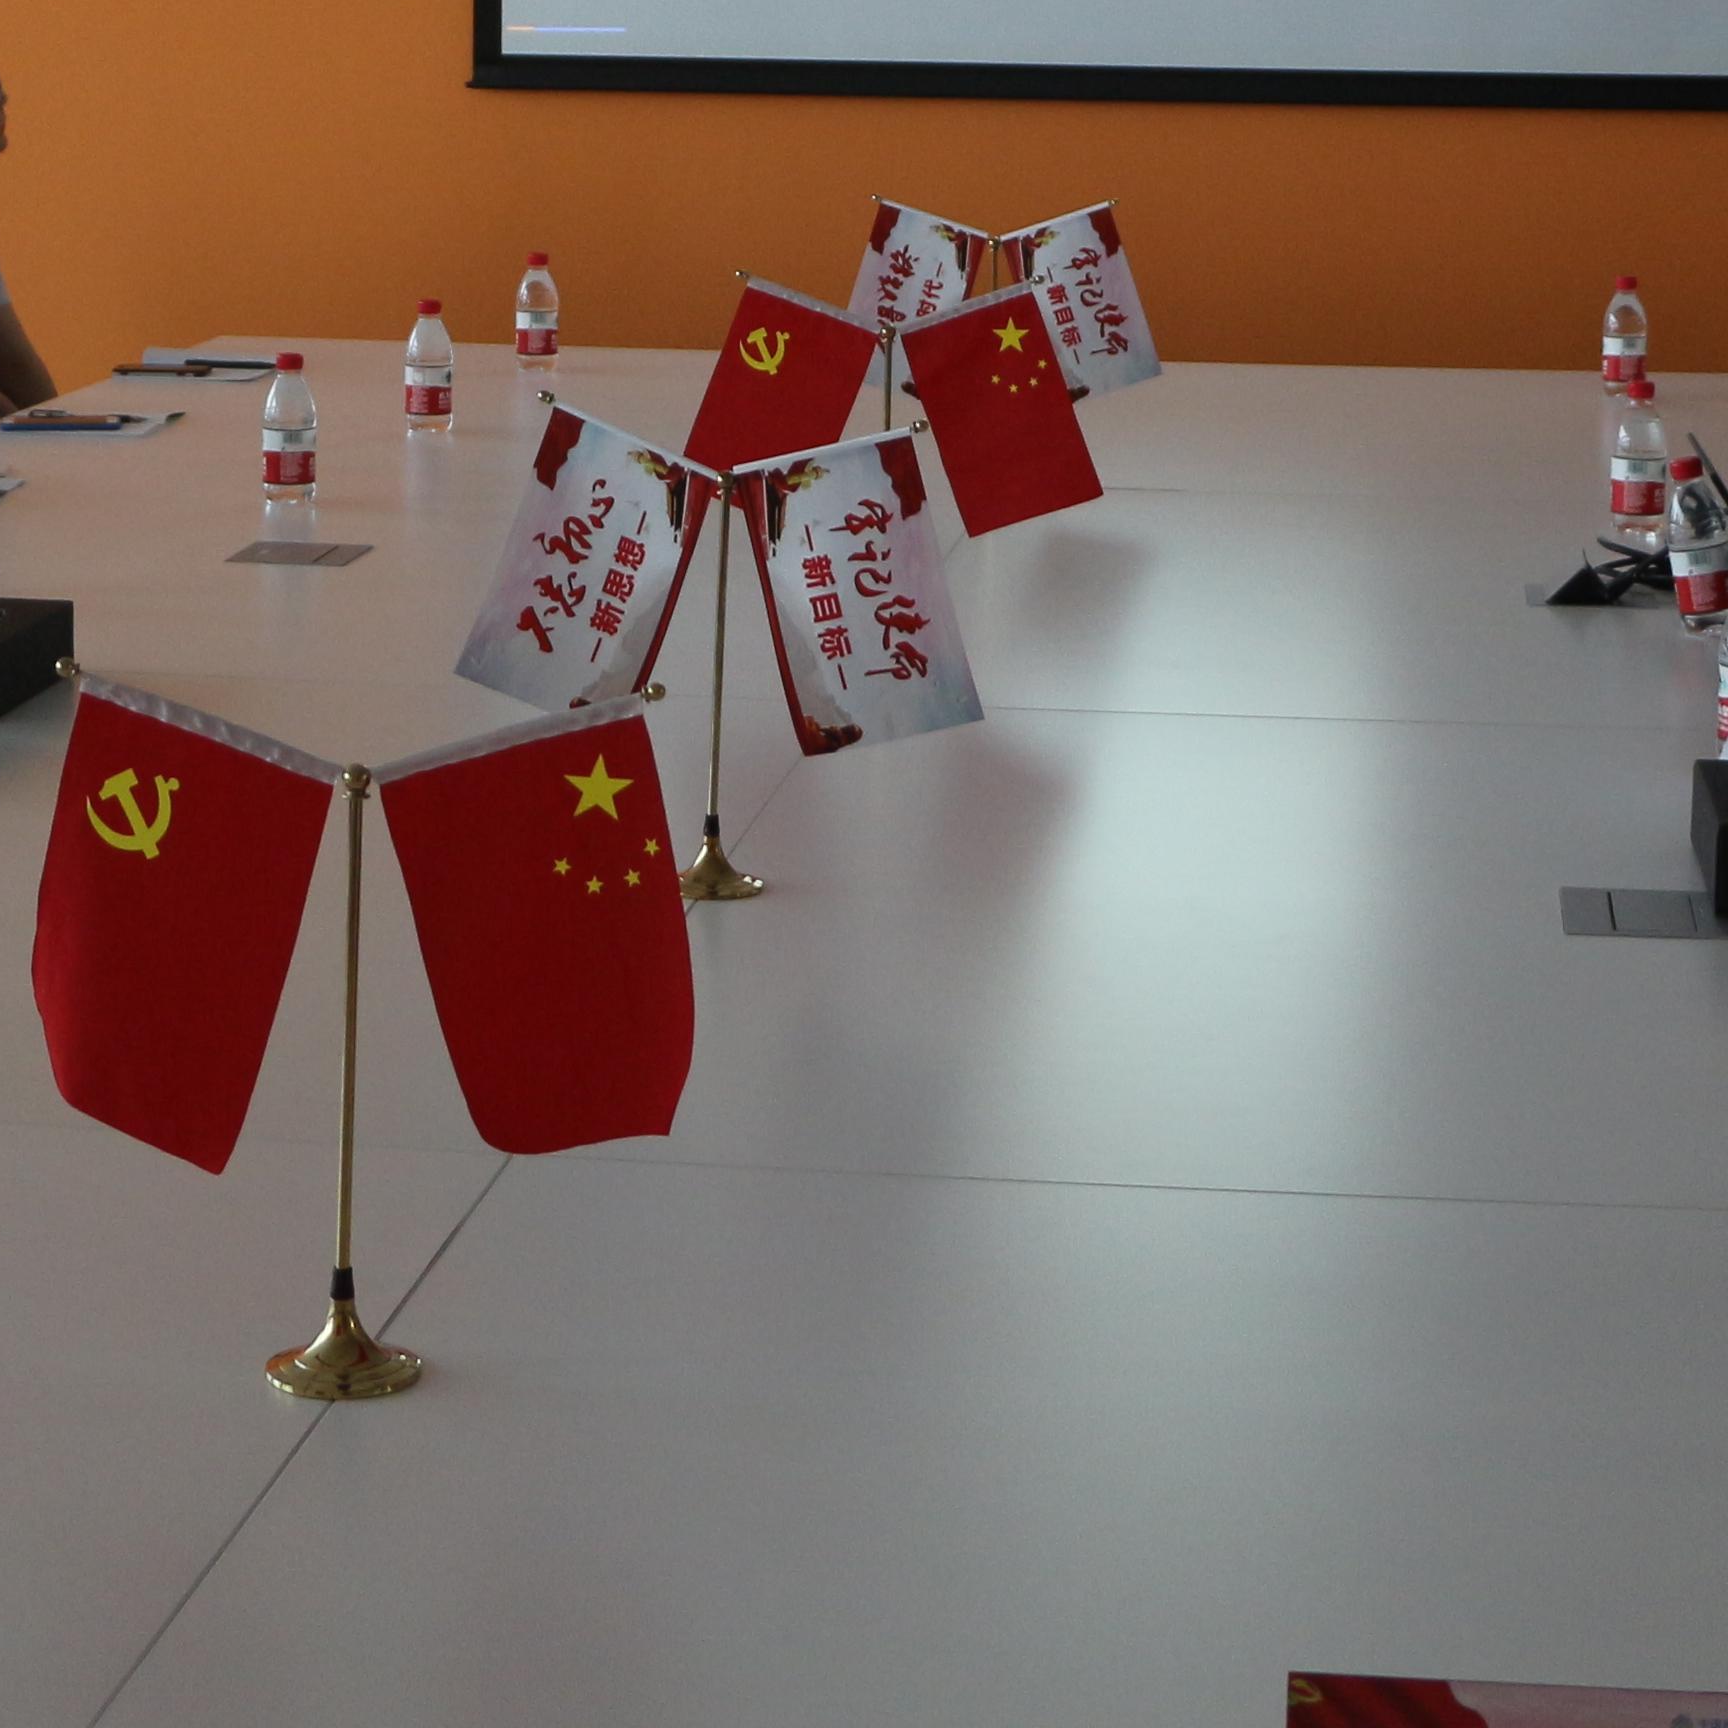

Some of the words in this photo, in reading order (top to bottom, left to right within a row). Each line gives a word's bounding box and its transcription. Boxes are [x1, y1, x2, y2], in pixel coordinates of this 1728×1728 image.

[516, 478, 615, 653] 不忘初心
[828, 498, 931, 680] 牢记使命
